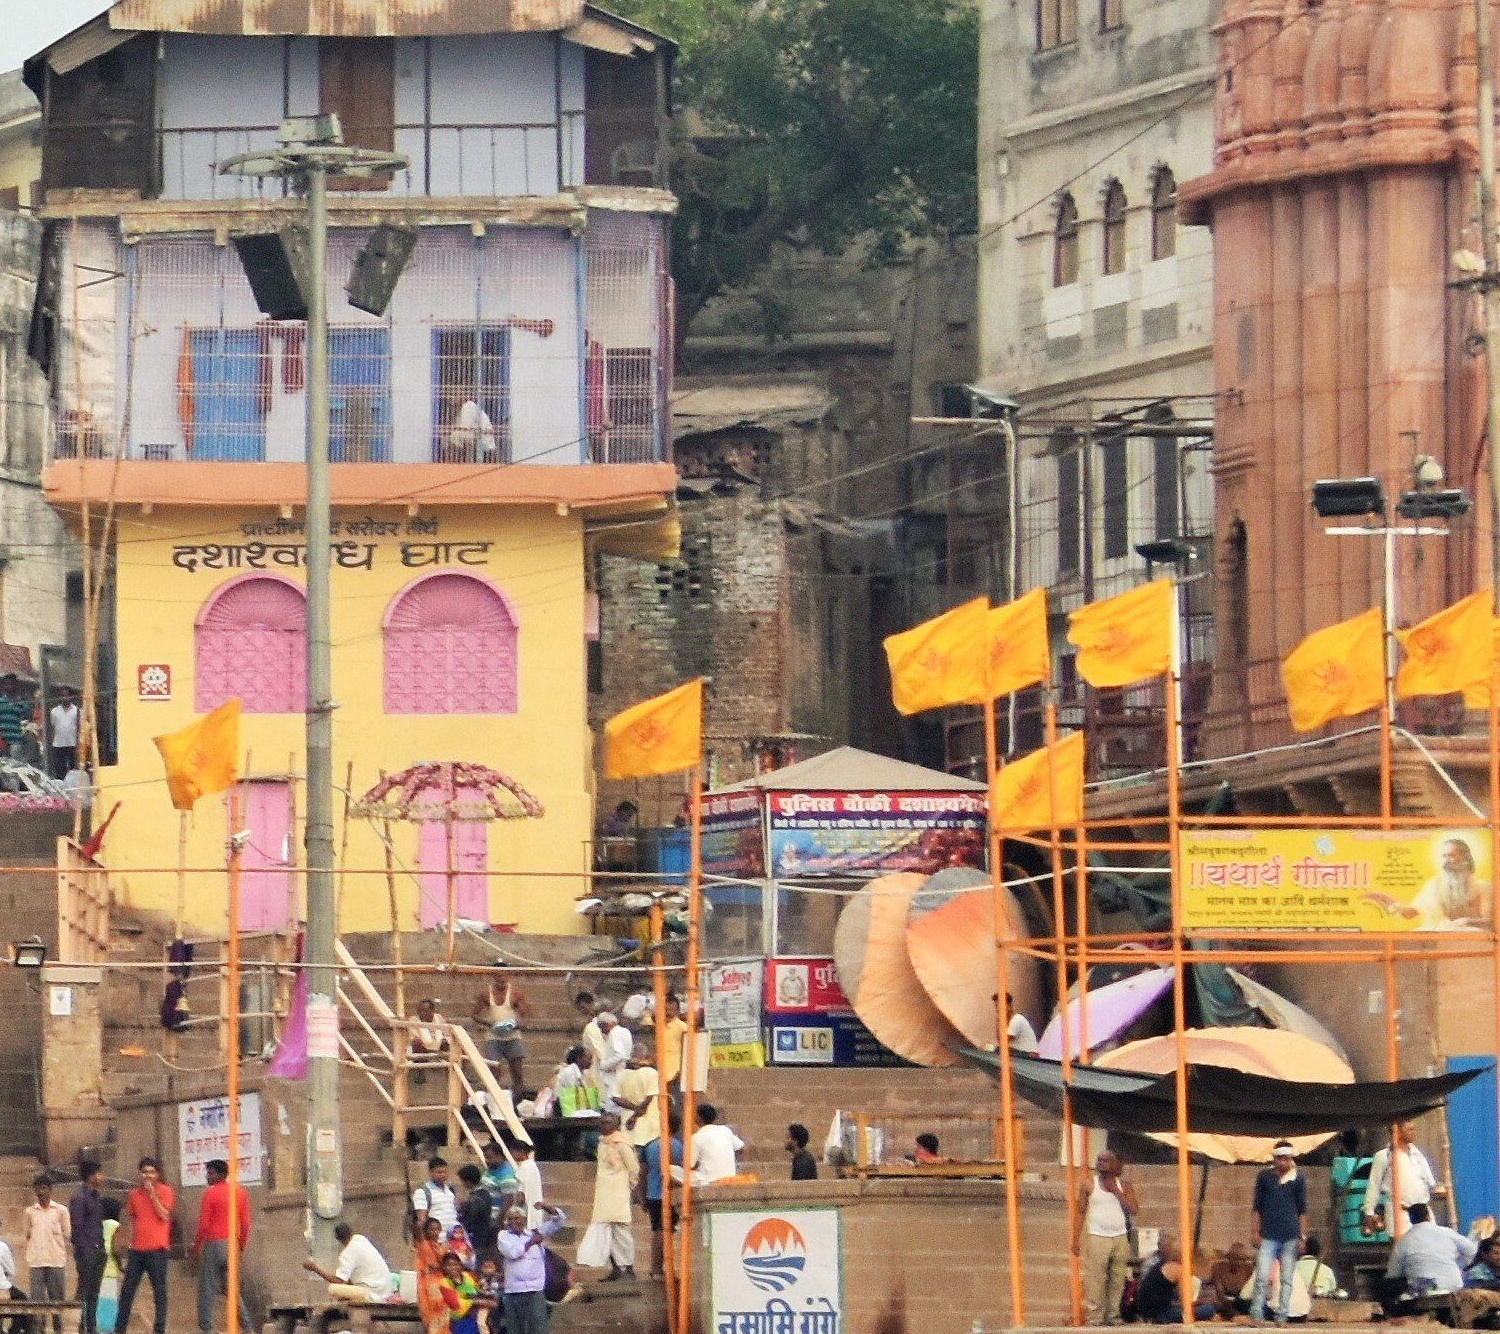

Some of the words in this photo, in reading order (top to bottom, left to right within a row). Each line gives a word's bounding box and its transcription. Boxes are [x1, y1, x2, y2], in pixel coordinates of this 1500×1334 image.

[400, 541, 495, 567] घाट
[777, 793, 836, 817] पुलिस
[841, 793, 894, 813] चौकी
[801, 1033, 828, 1051] LIC
